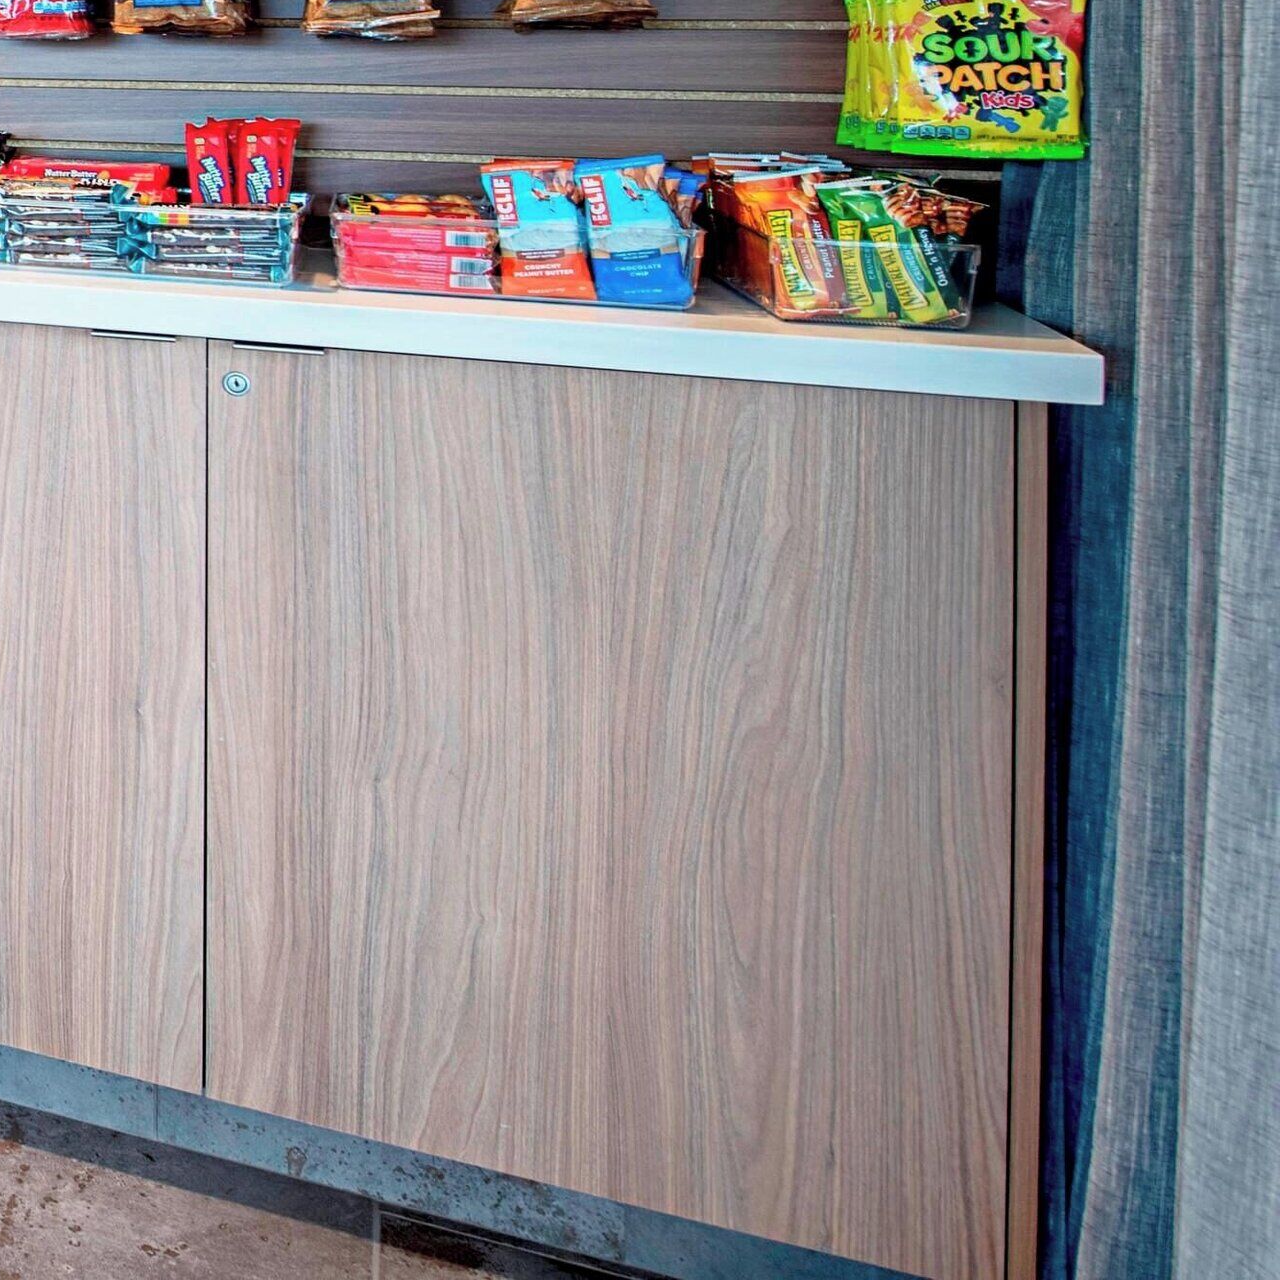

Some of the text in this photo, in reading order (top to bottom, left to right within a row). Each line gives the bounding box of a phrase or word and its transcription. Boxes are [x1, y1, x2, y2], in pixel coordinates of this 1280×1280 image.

[924, 29, 1055, 63] SOUR
[930, 61, 1064, 92] PATCH
[981, 90, 1035, 110] Kids
[44, 168, 97, 179] Nutter Butter
[200, 156, 225, 188] Nutter
[250, 156, 272, 189] Nutter
[198, 173, 222, 203] Butter
[246, 172, 267, 204] Butter
[917, 228, 934, 256] Honey
[514, 270, 544, 278] PEANUT
[524, 263, 562, 271] CRUNCHY
[614, 263, 662, 272] CHOCOLATE
[820, 244, 835, 279] Peanut
[873, 227, 919, 307] NATURE VALLEY
[932, 265, 948, 287] Oats
[843, 258, 868, 303] NATURE
